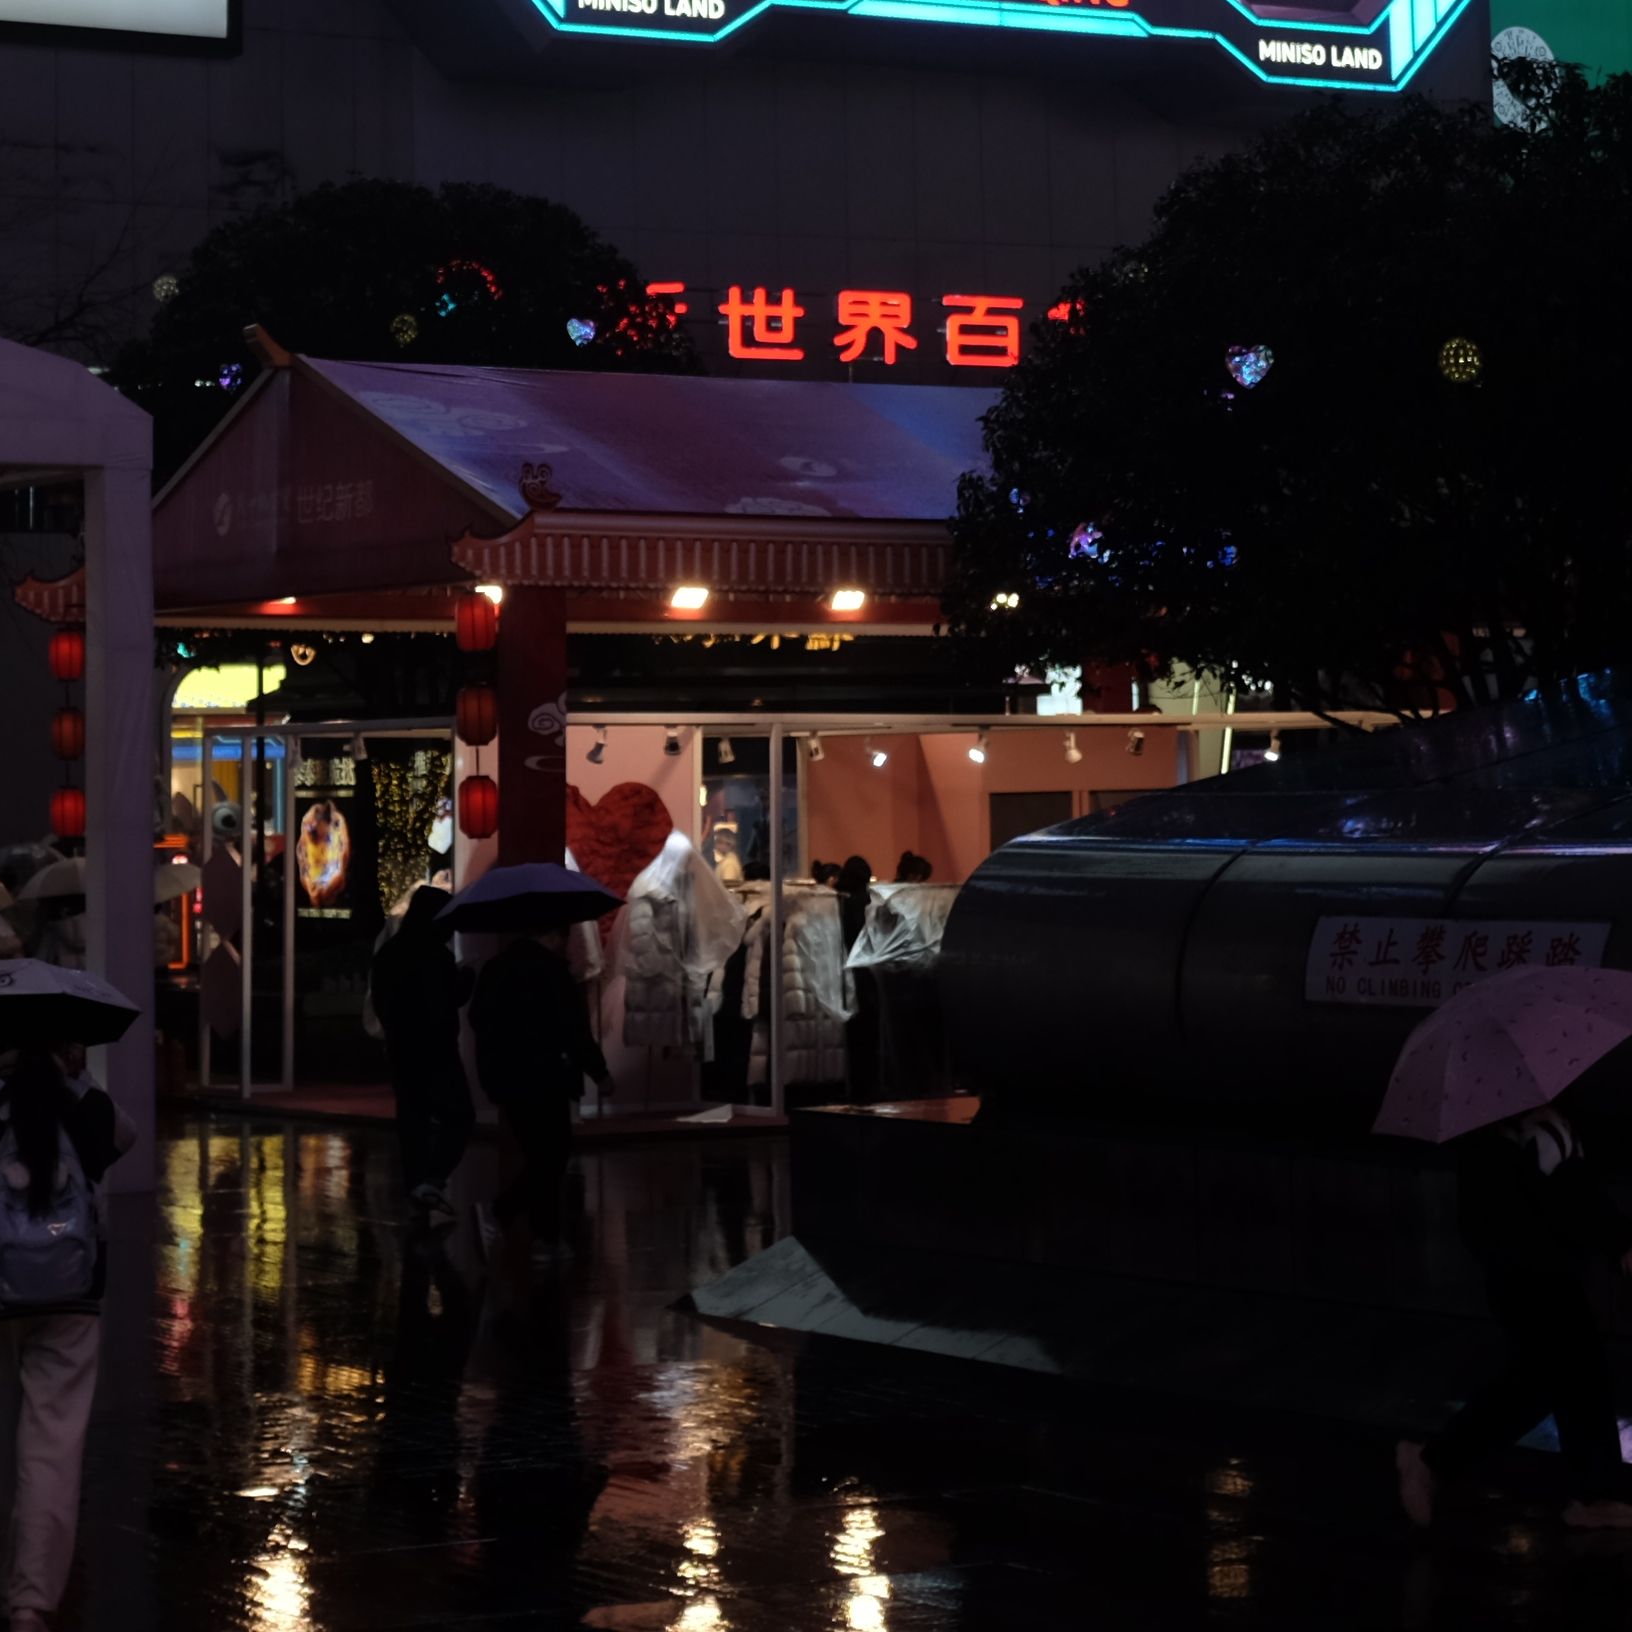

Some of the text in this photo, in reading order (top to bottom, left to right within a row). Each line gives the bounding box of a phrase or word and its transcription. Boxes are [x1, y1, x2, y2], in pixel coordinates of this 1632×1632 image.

[1258, 39, 1383, 70] MINISO LAND
[1329, 922, 1582, 975] 禁止攀爬踩踏
[1325, 975, 1346, 994] NO
[1356, 976, 1441, 998] CLIMBING
